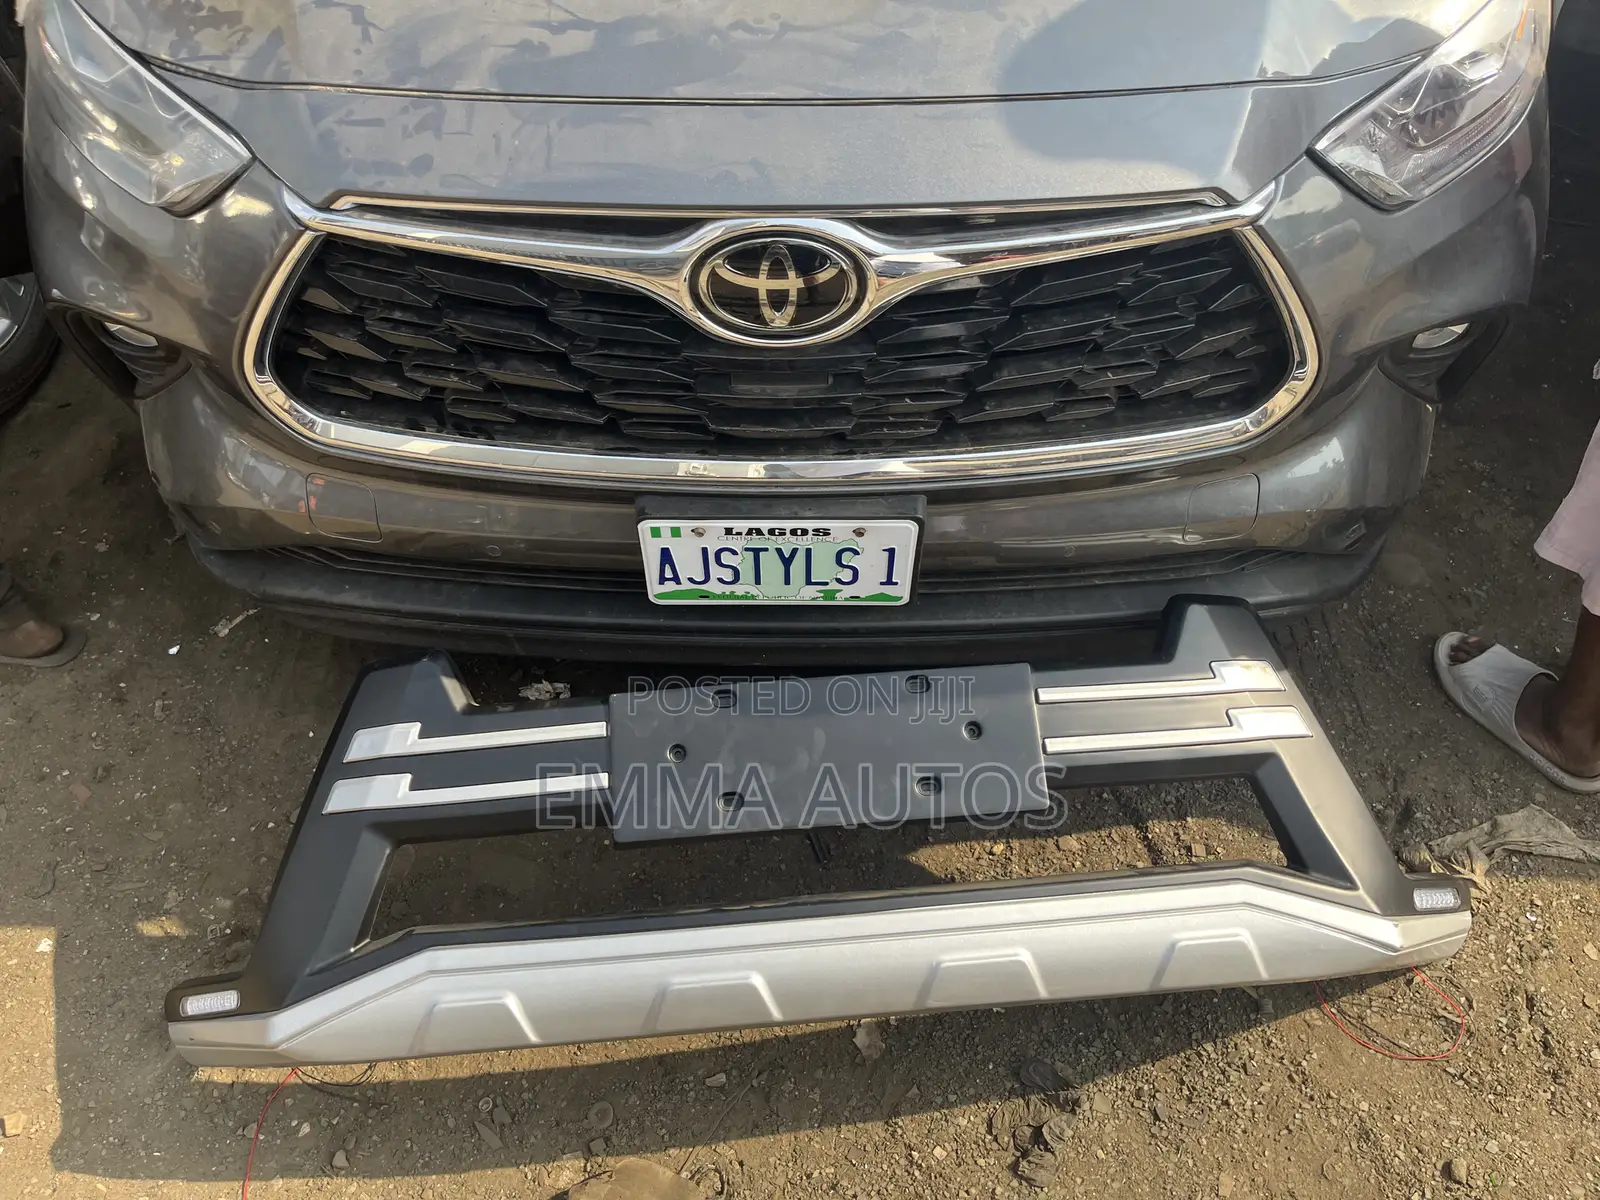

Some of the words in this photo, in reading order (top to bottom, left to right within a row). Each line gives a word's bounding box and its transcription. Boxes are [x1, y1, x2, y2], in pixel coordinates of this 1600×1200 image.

[723, 527, 832, 537] LAGOS
[658, 546, 861, 586] AJSTYLS
[879, 546, 899, 586] 1
